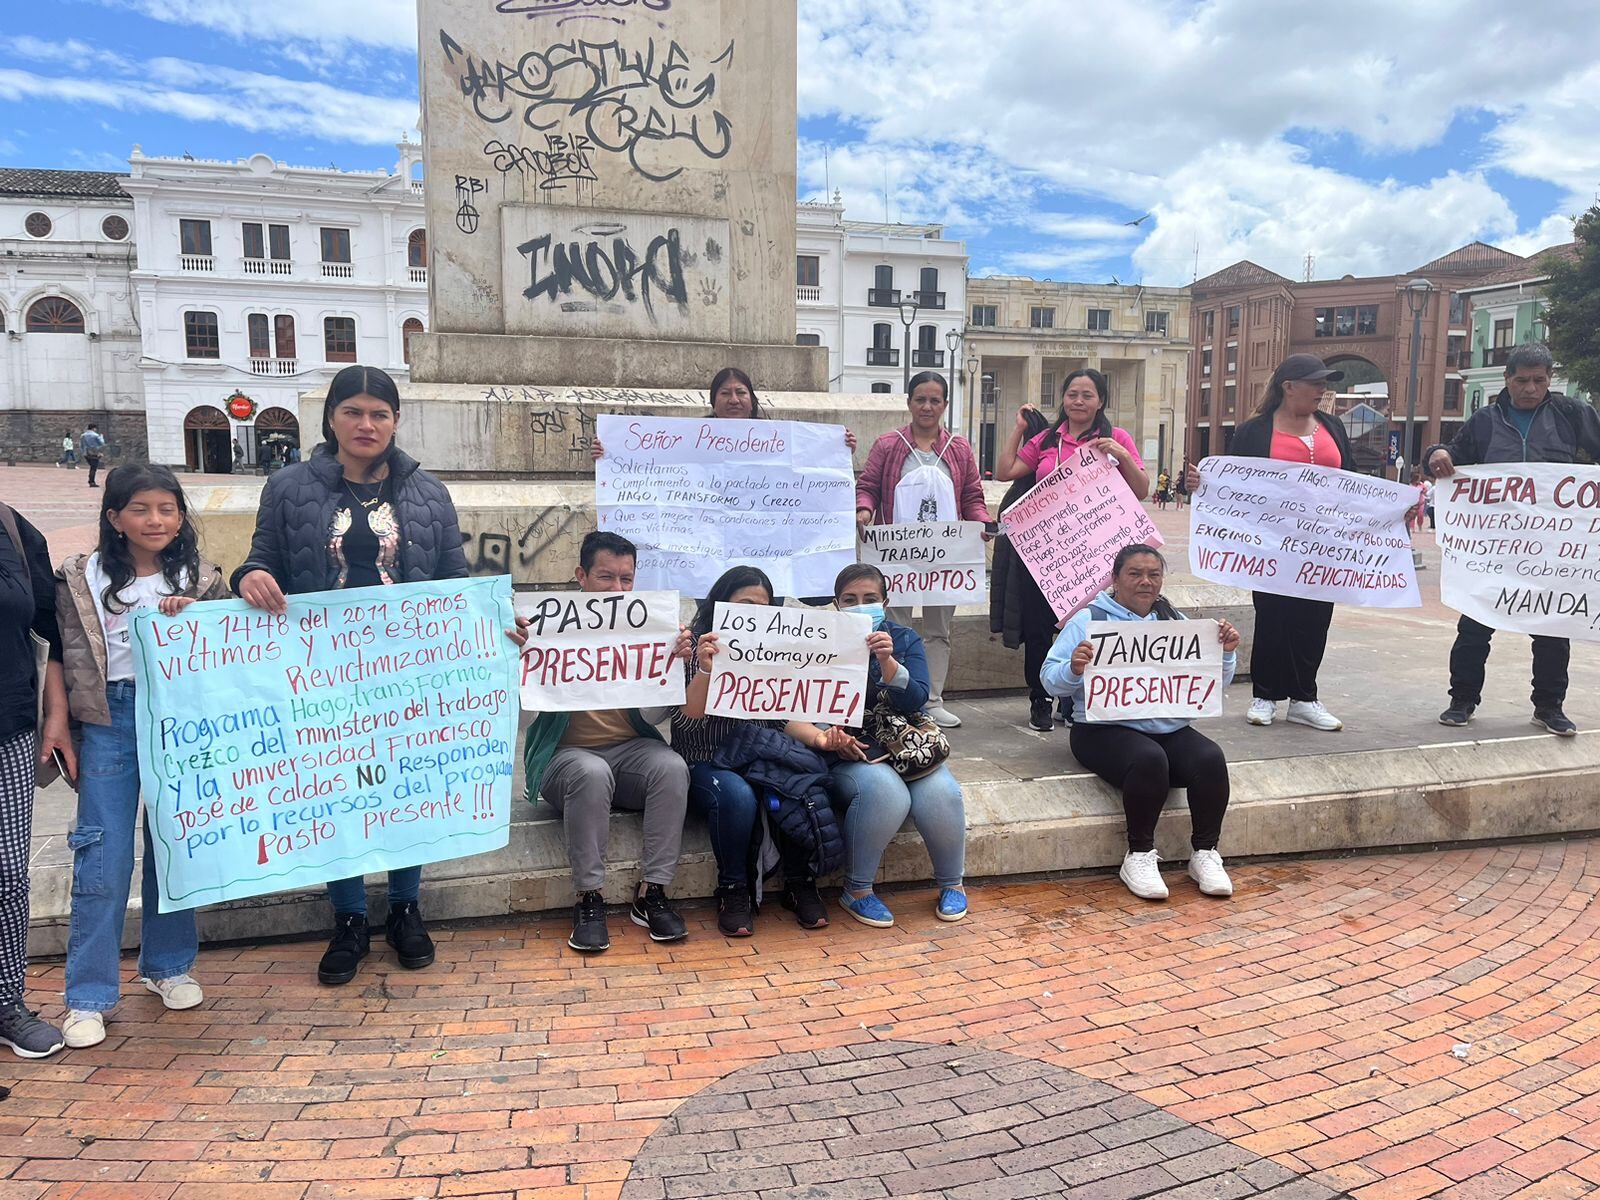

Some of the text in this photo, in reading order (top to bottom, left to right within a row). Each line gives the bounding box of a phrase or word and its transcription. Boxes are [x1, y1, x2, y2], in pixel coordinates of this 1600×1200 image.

[625, 423, 785, 453] Señor Presidente
[723, 475, 770, 492] pactado
[775, 480, 788, 489] en
[792, 475, 804, 489] el
[807, 479, 850, 493] programa
[1200, 458, 1219, 473] El
[1218, 463, 1288, 481] programa
[666, 490, 740, 506] TRANSFORMO
[1217, 485, 1267, 505] Crezco
[1279, 500, 1307, 513] nos
[1450, 476, 1537, 505] FUERA
[614, 508, 636, 522] Que
[641, 512, 655, 521] se
[719, 512, 776, 526] condiciones
[799, 514, 840, 525] nosotros
[1057, 521, 1072, 535] del
[1257, 512, 1286, 525] por
[1445, 510, 1573, 532] UNIVERSIDAD
[864, 525, 962, 551] Ministerio del
[1442, 533, 1543, 556] MINISTERIO
[636, 556, 696, 570] ORRUPTOS
[1198, 546, 1277, 577] VICTIMAS
[1465, 560, 1503, 575] este
[883, 570, 977, 594] ORRUPTOS
[218, 613, 290, 643] 1448
[299, 608, 329, 633] del
[343, 602, 388, 624] 2011
[537, 595, 648, 636] PASTO
[720, 609, 828, 640] Los Andes
[331, 624, 376, 651] nos
[385, 616, 463, 641] estan
[728, 639, 838, 669] Sotomayor
[1091, 632, 1202, 666] TANGUA
[520, 642, 677, 687] PRESENTE!
[713, 671, 860, 724] PRESENTE!
[1087, 675, 1216, 711] PRESENTE!
[160, 704, 281, 750] Programa
[251, 727, 287, 759] del
[404, 697, 429, 721] del
[196, 774, 219, 800] la
[230, 796, 258, 815] de
[356, 763, 386, 790] NO
[186, 824, 233, 859] por
[393, 778, 431, 801] del
[257, 819, 336, 865] Pasto
